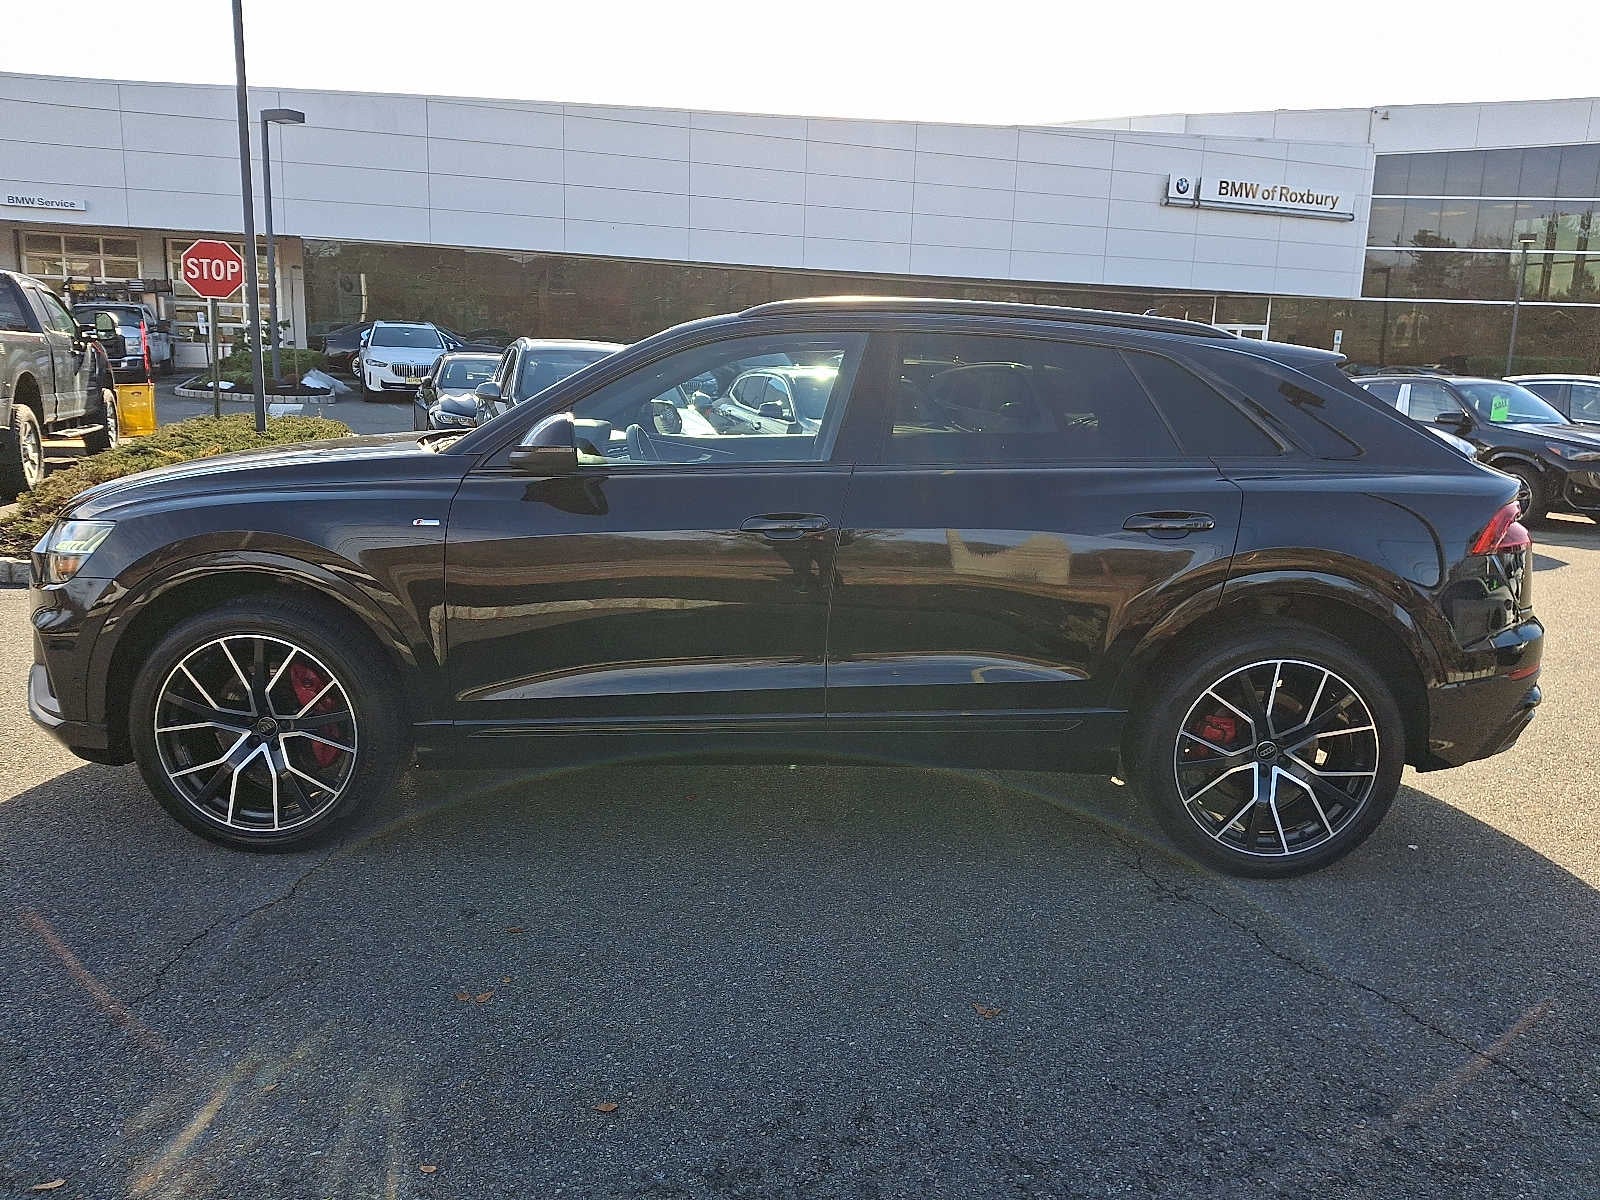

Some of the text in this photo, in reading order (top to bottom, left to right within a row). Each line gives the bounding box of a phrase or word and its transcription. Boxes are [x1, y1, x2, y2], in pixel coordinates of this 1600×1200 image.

[7, 195, 76, 208] BMW Service
[1218, 180, 1339, 209] BMW of Roxbury
[186, 257, 240, 281] STOP
